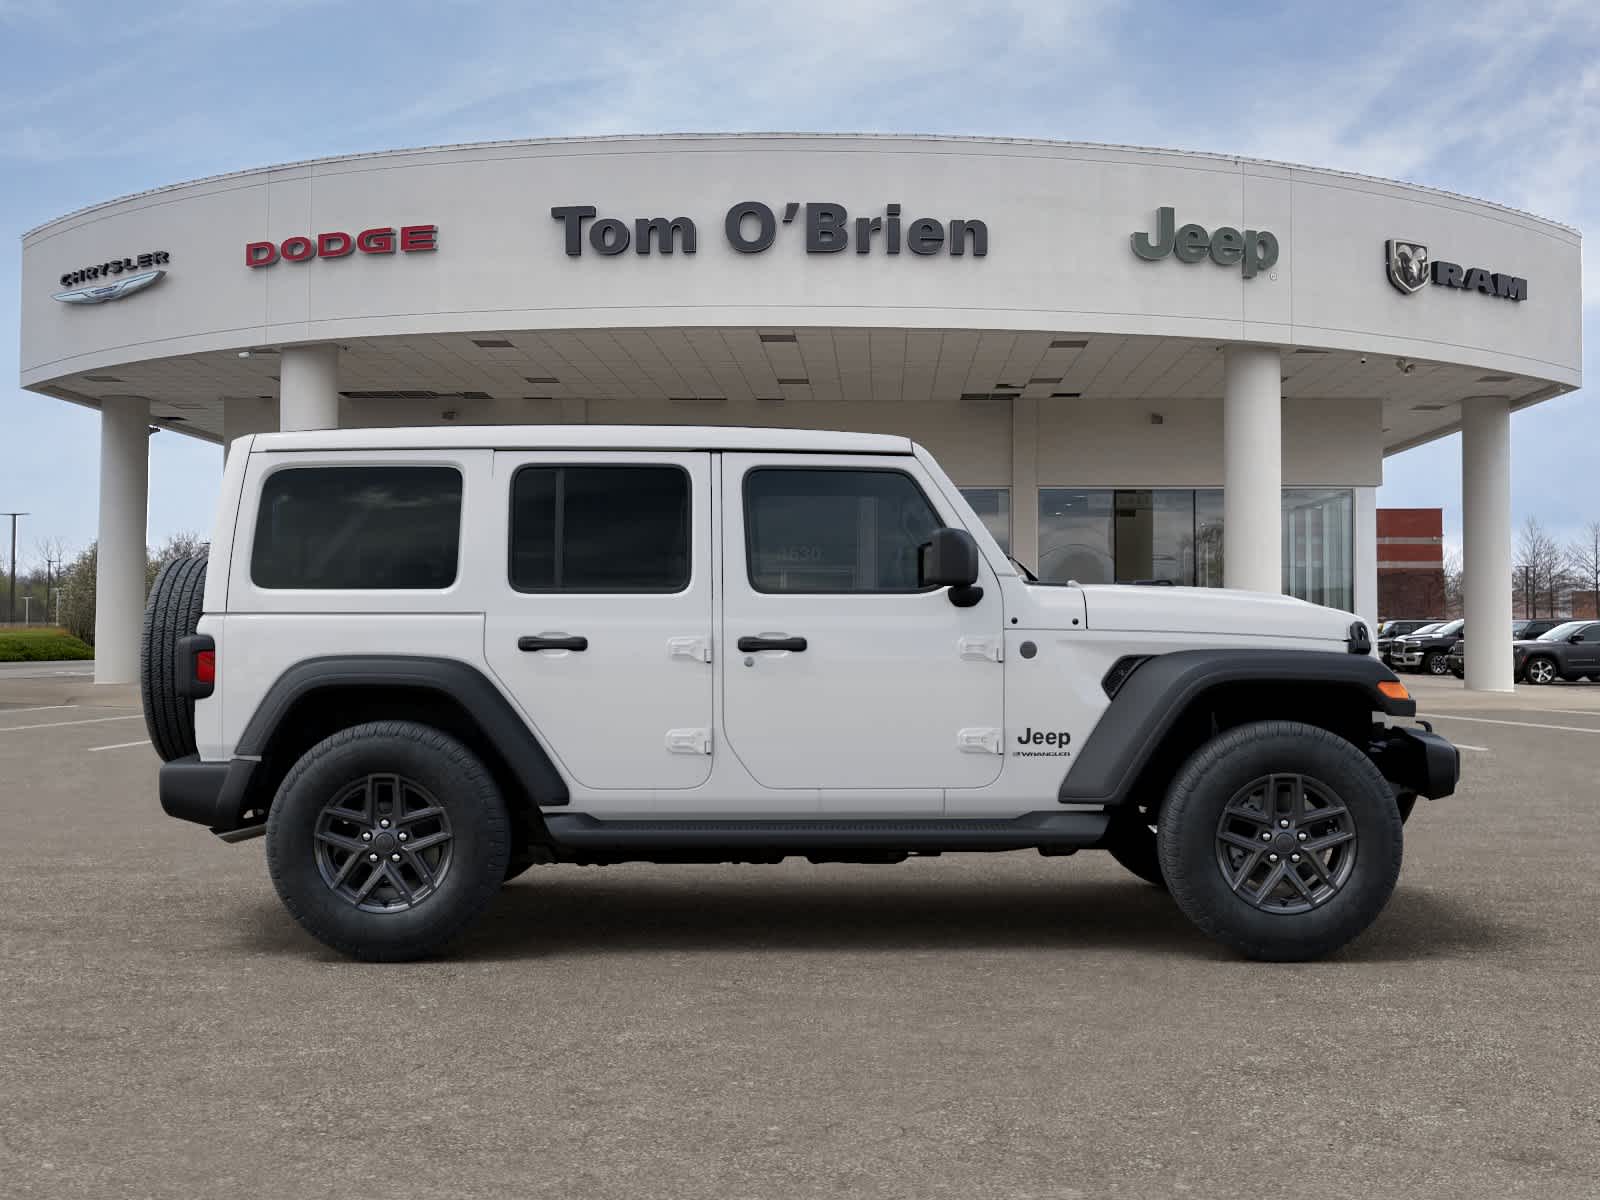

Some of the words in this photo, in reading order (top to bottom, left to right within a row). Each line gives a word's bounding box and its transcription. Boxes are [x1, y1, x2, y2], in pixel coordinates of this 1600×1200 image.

[245, 224, 438, 269] DODGE
[550, 205, 697, 257] Tom
[724, 200, 989, 257] O'Brien
[1130, 206, 1280, 279] Jeep
[60, 250, 170, 286] CHRYSLER
[1431, 260, 1528, 302] RAM
[1017, 727, 1071, 749] Jeep
